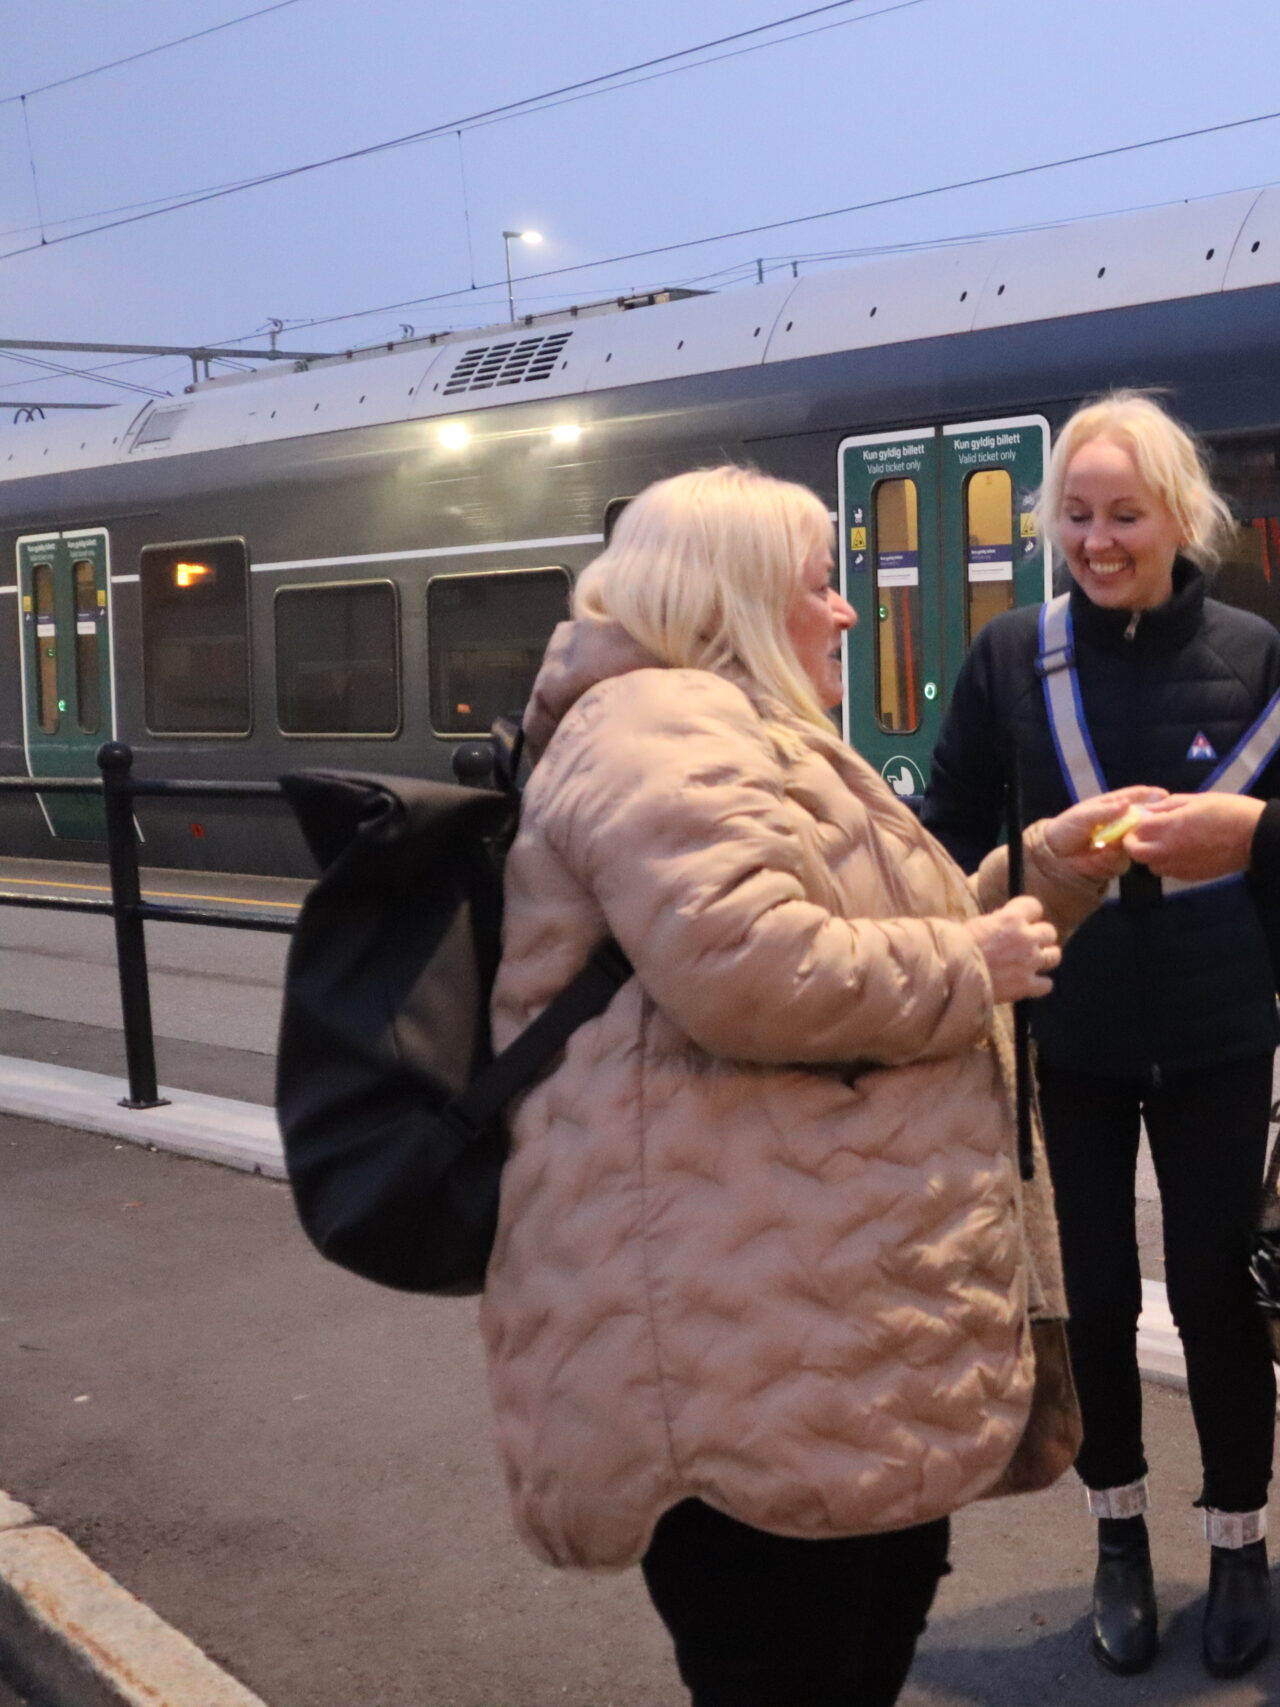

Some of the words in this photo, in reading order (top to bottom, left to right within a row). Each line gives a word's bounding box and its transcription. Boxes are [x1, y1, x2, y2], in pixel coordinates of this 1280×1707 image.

[954, 439, 969, 450] Kun
[971, 436, 995, 449] gyldig
[996, 433, 1020, 445] billett
[863, 450, 877, 461] Kun
[878, 448, 901, 461] gyldig
[902, 444, 925, 456] billett
[958, 453, 975, 464] Valid
[978, 451, 999, 462] ticket
[1000, 450, 1016, 462] only
[867, 464, 884, 475] Valid
[885, 461, 905, 473] ticket
[906, 460, 921, 472] only
